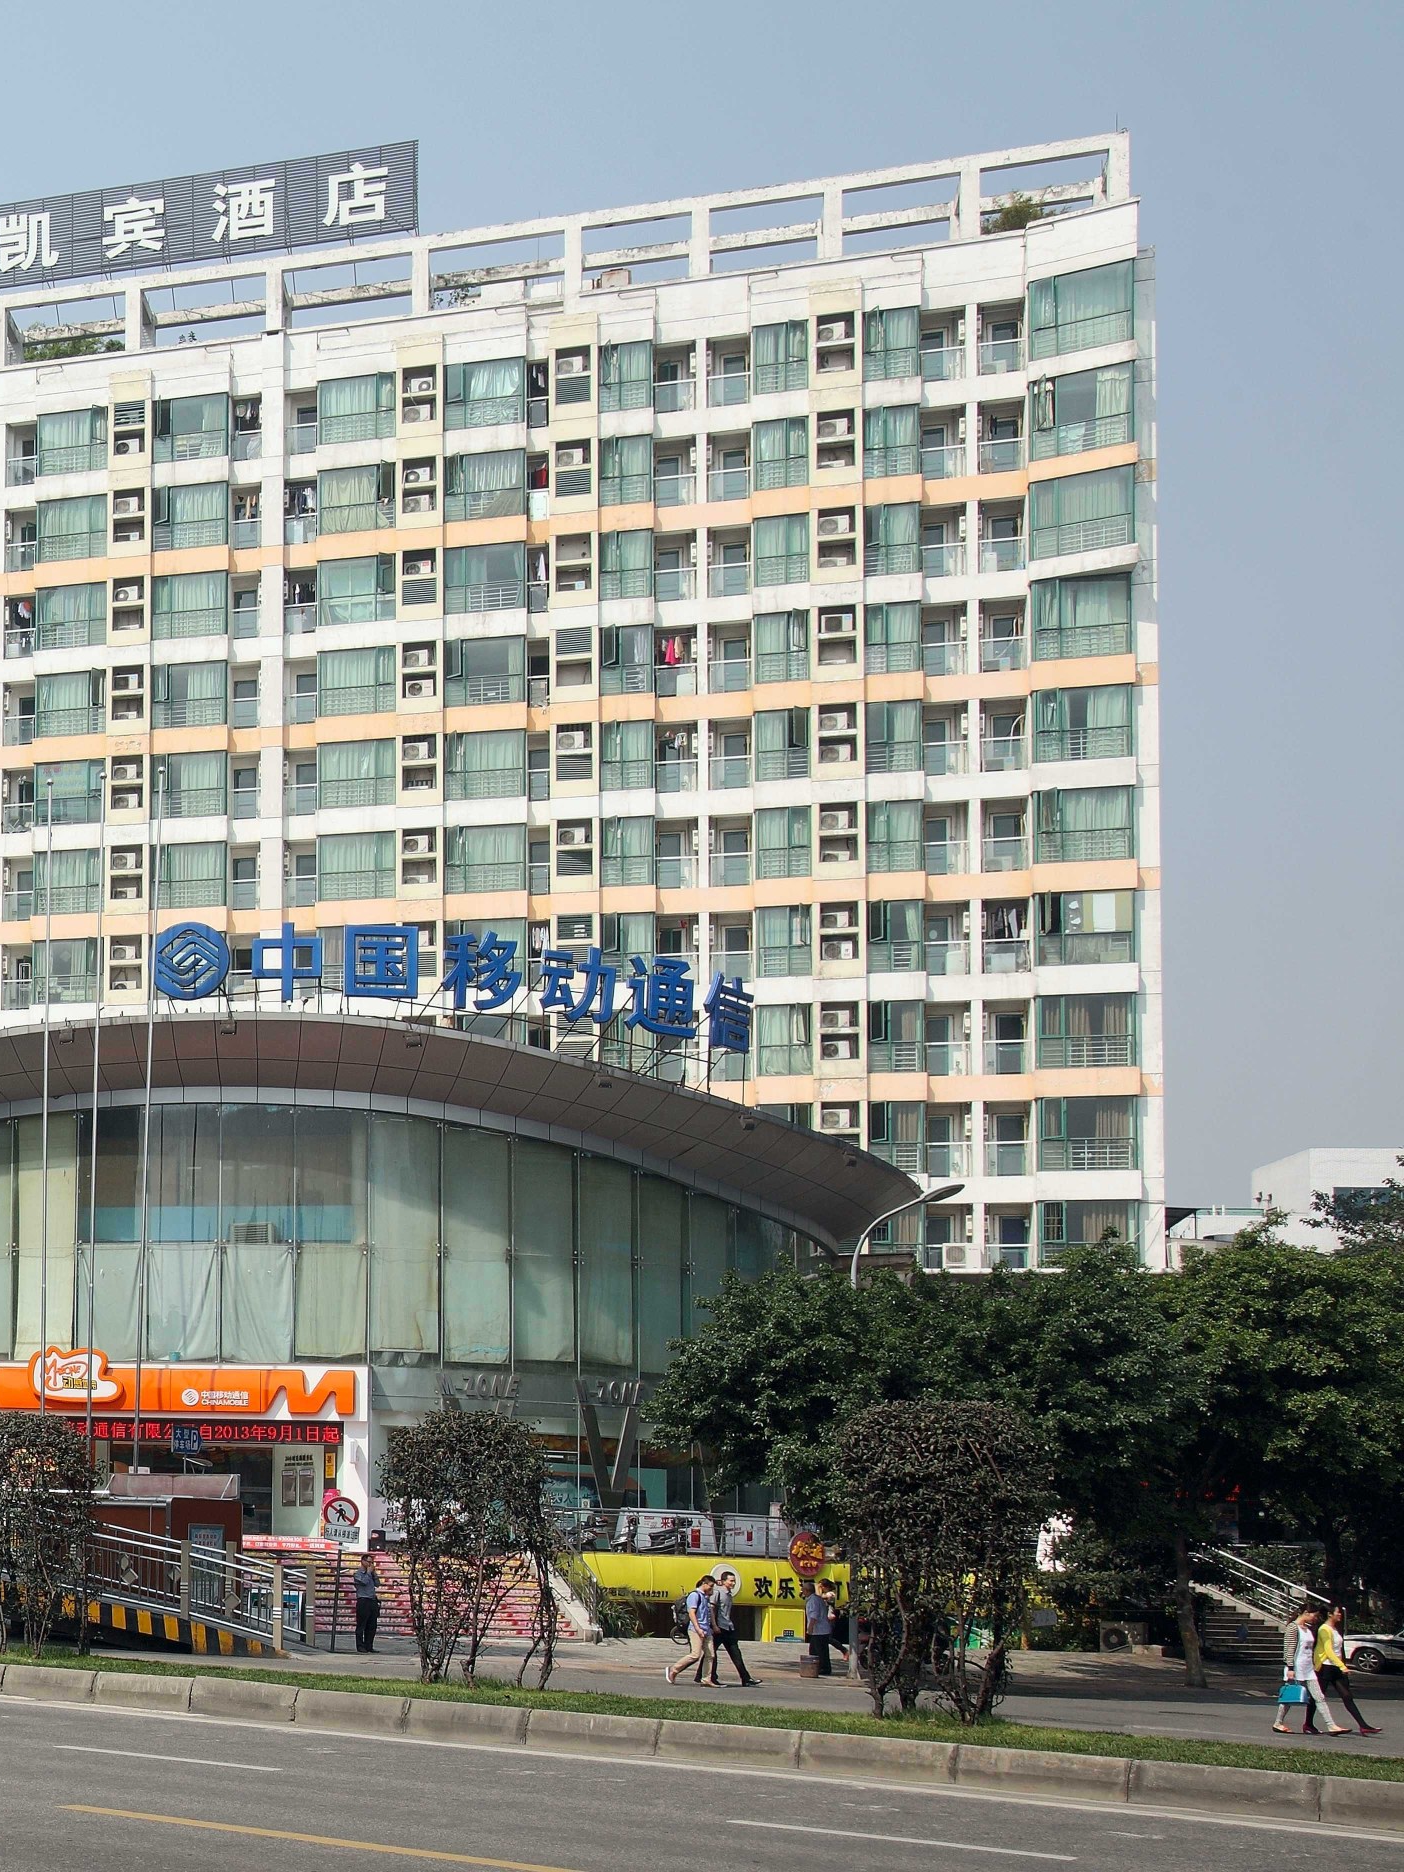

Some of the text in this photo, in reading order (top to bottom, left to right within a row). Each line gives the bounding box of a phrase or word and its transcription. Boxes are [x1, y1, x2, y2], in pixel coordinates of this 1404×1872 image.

[252, 921, 754, 1054] 中国移动通信
[436, 1373, 521, 1399] M-ZONE
[191, 1430, 198, 1450] P
